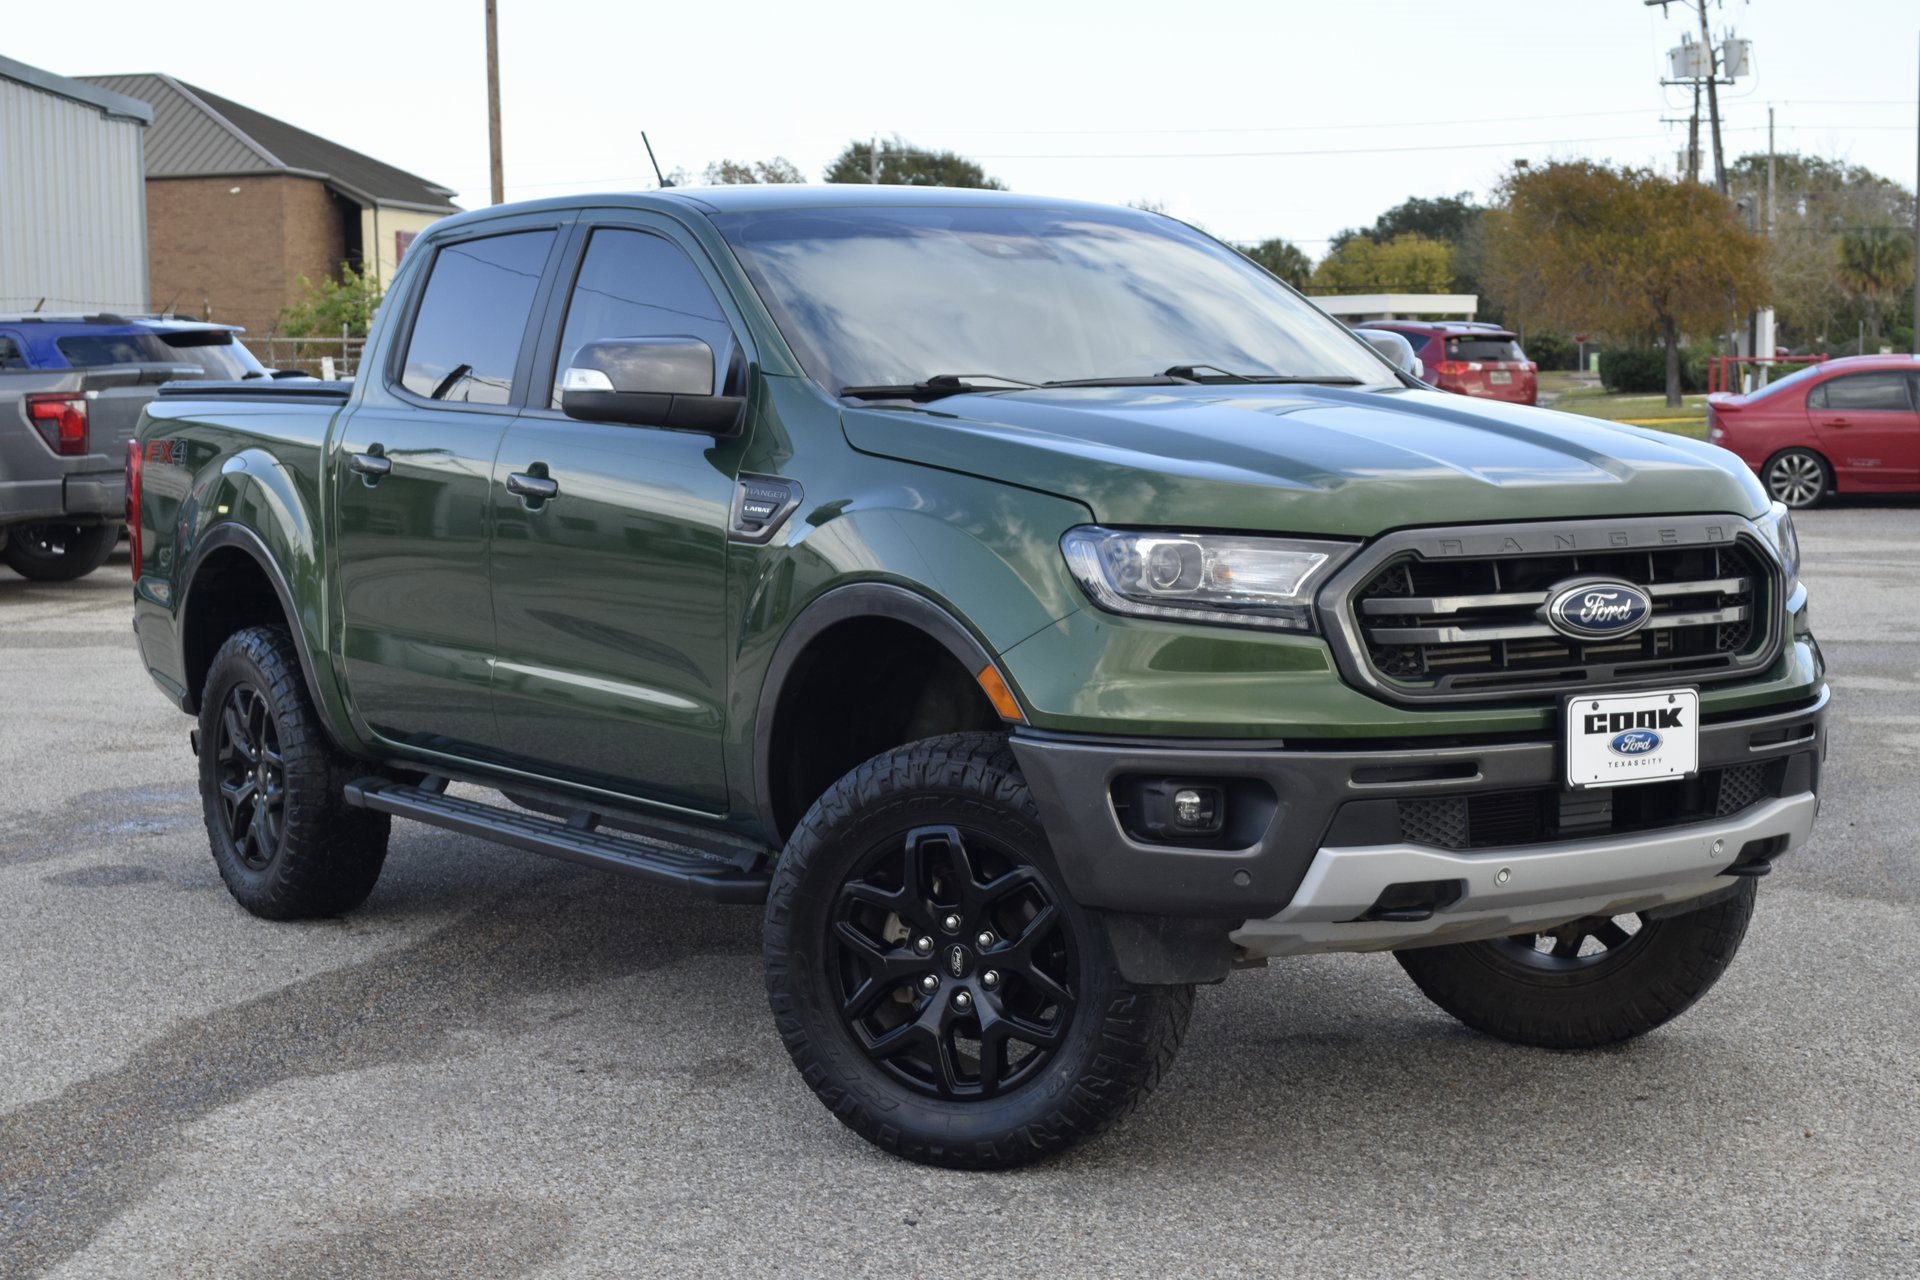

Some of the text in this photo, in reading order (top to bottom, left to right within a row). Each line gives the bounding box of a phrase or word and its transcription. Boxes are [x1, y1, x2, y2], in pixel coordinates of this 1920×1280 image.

[146, 439, 188, 465] FX4
[746, 487, 788, 500] RANGER
[1439, 525, 1725, 555] RANGER
[1580, 591, 1632, 623] Ford
[1584, 707, 1683, 735] COOK
[1621, 734, 1651, 752] Ford
[1609, 760, 1639, 768] TEXAS
